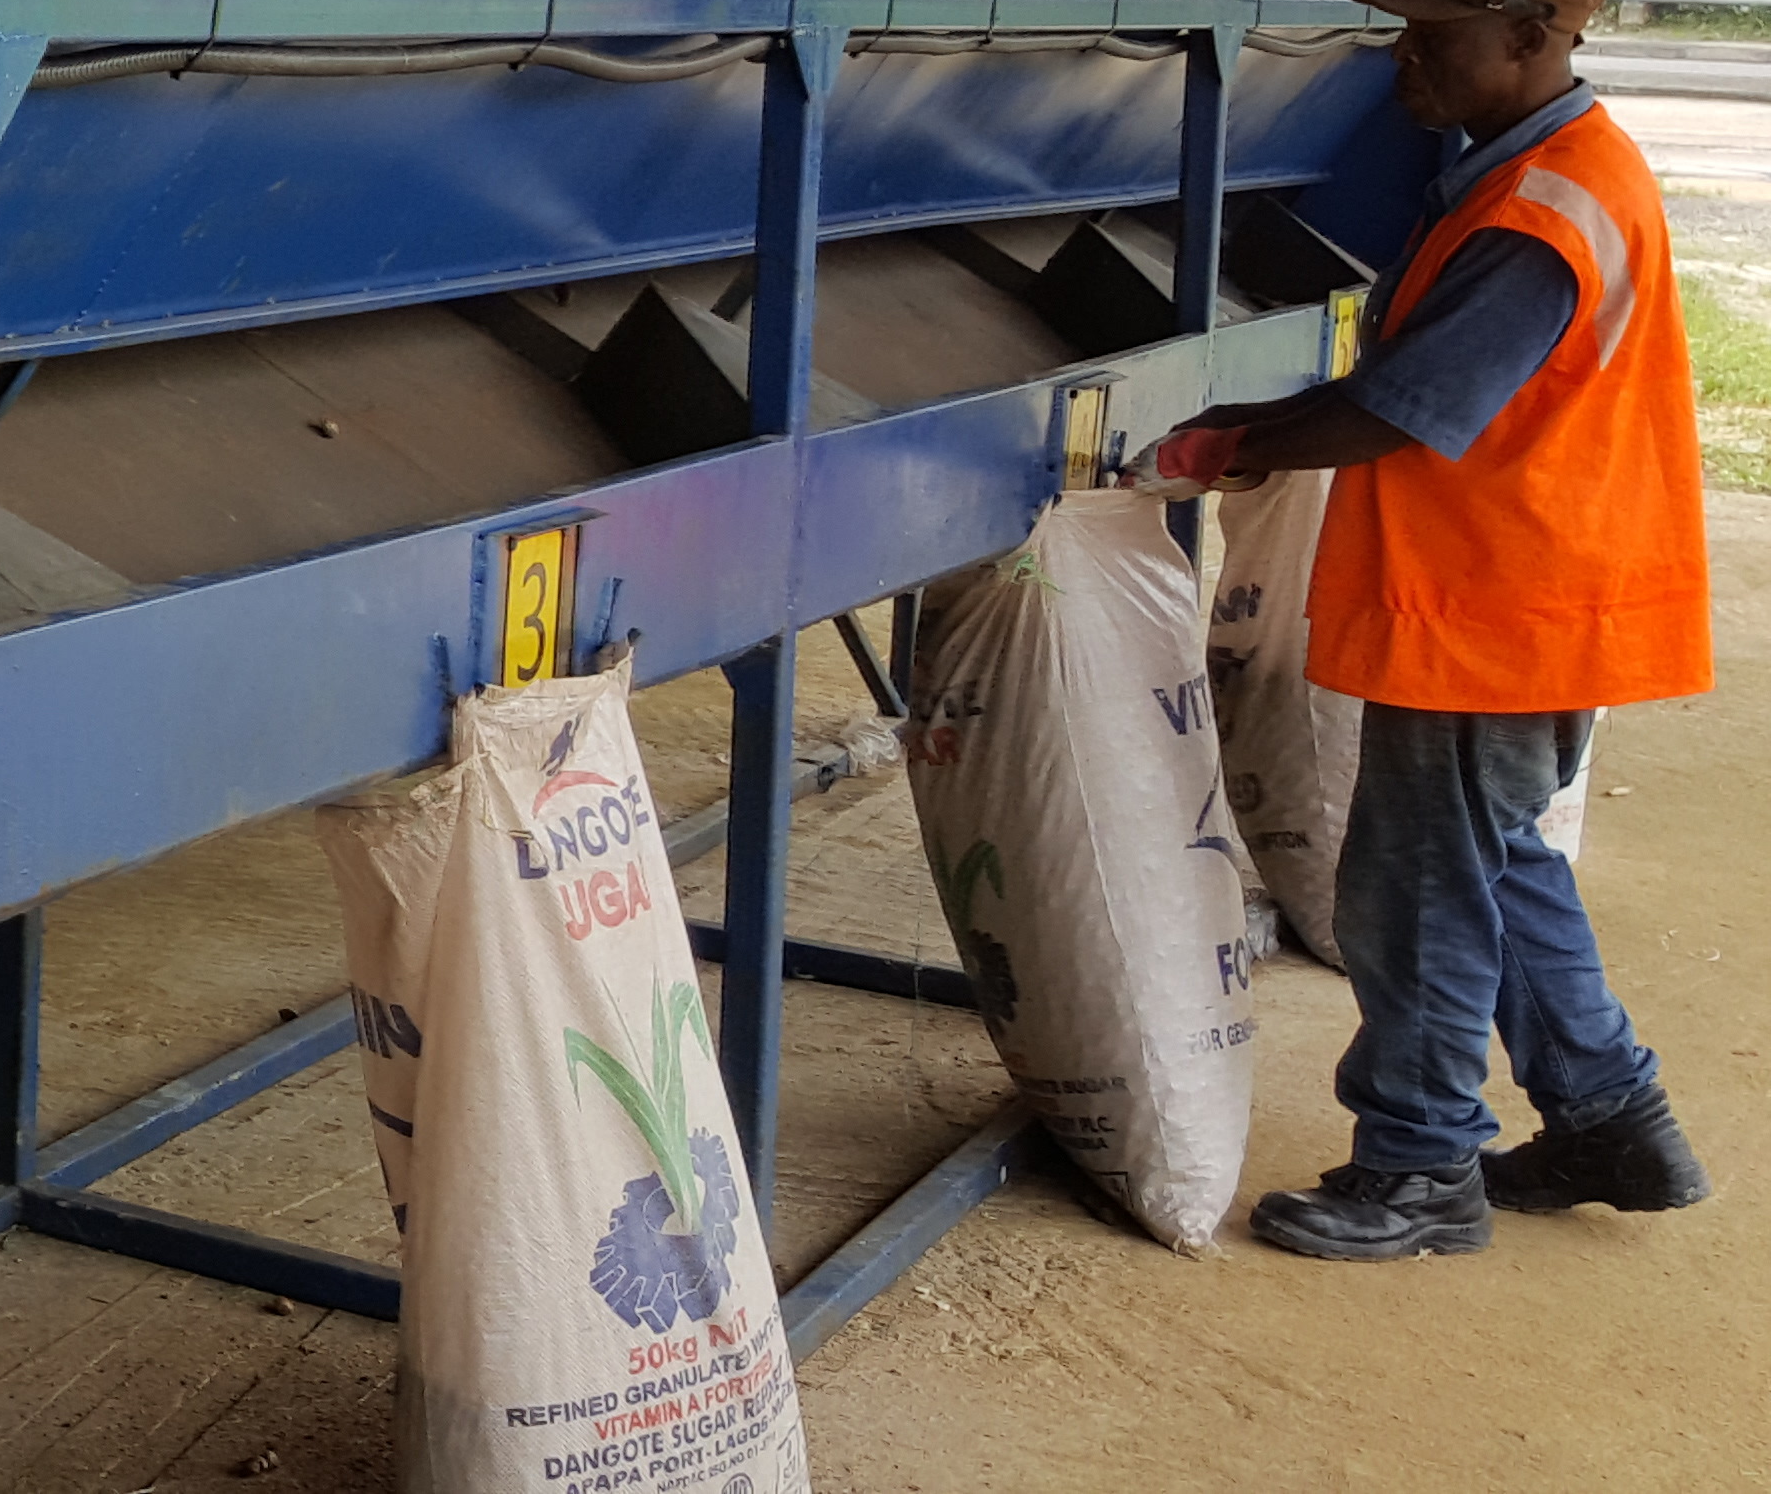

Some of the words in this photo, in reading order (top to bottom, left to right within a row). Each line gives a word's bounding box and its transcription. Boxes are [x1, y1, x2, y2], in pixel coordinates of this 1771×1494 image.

[517, 562, 547, 682] 3
[628, 1336, 699, 1375] 50kg
[506, 1392, 619, 1427] REFINED
[593, 1401, 682, 1441] VITAMIN
[687, 1395, 701, 1417] A
[544, 1432, 664, 1480] DANGOTE
[671, 1410, 737, 1448] SUGAR
